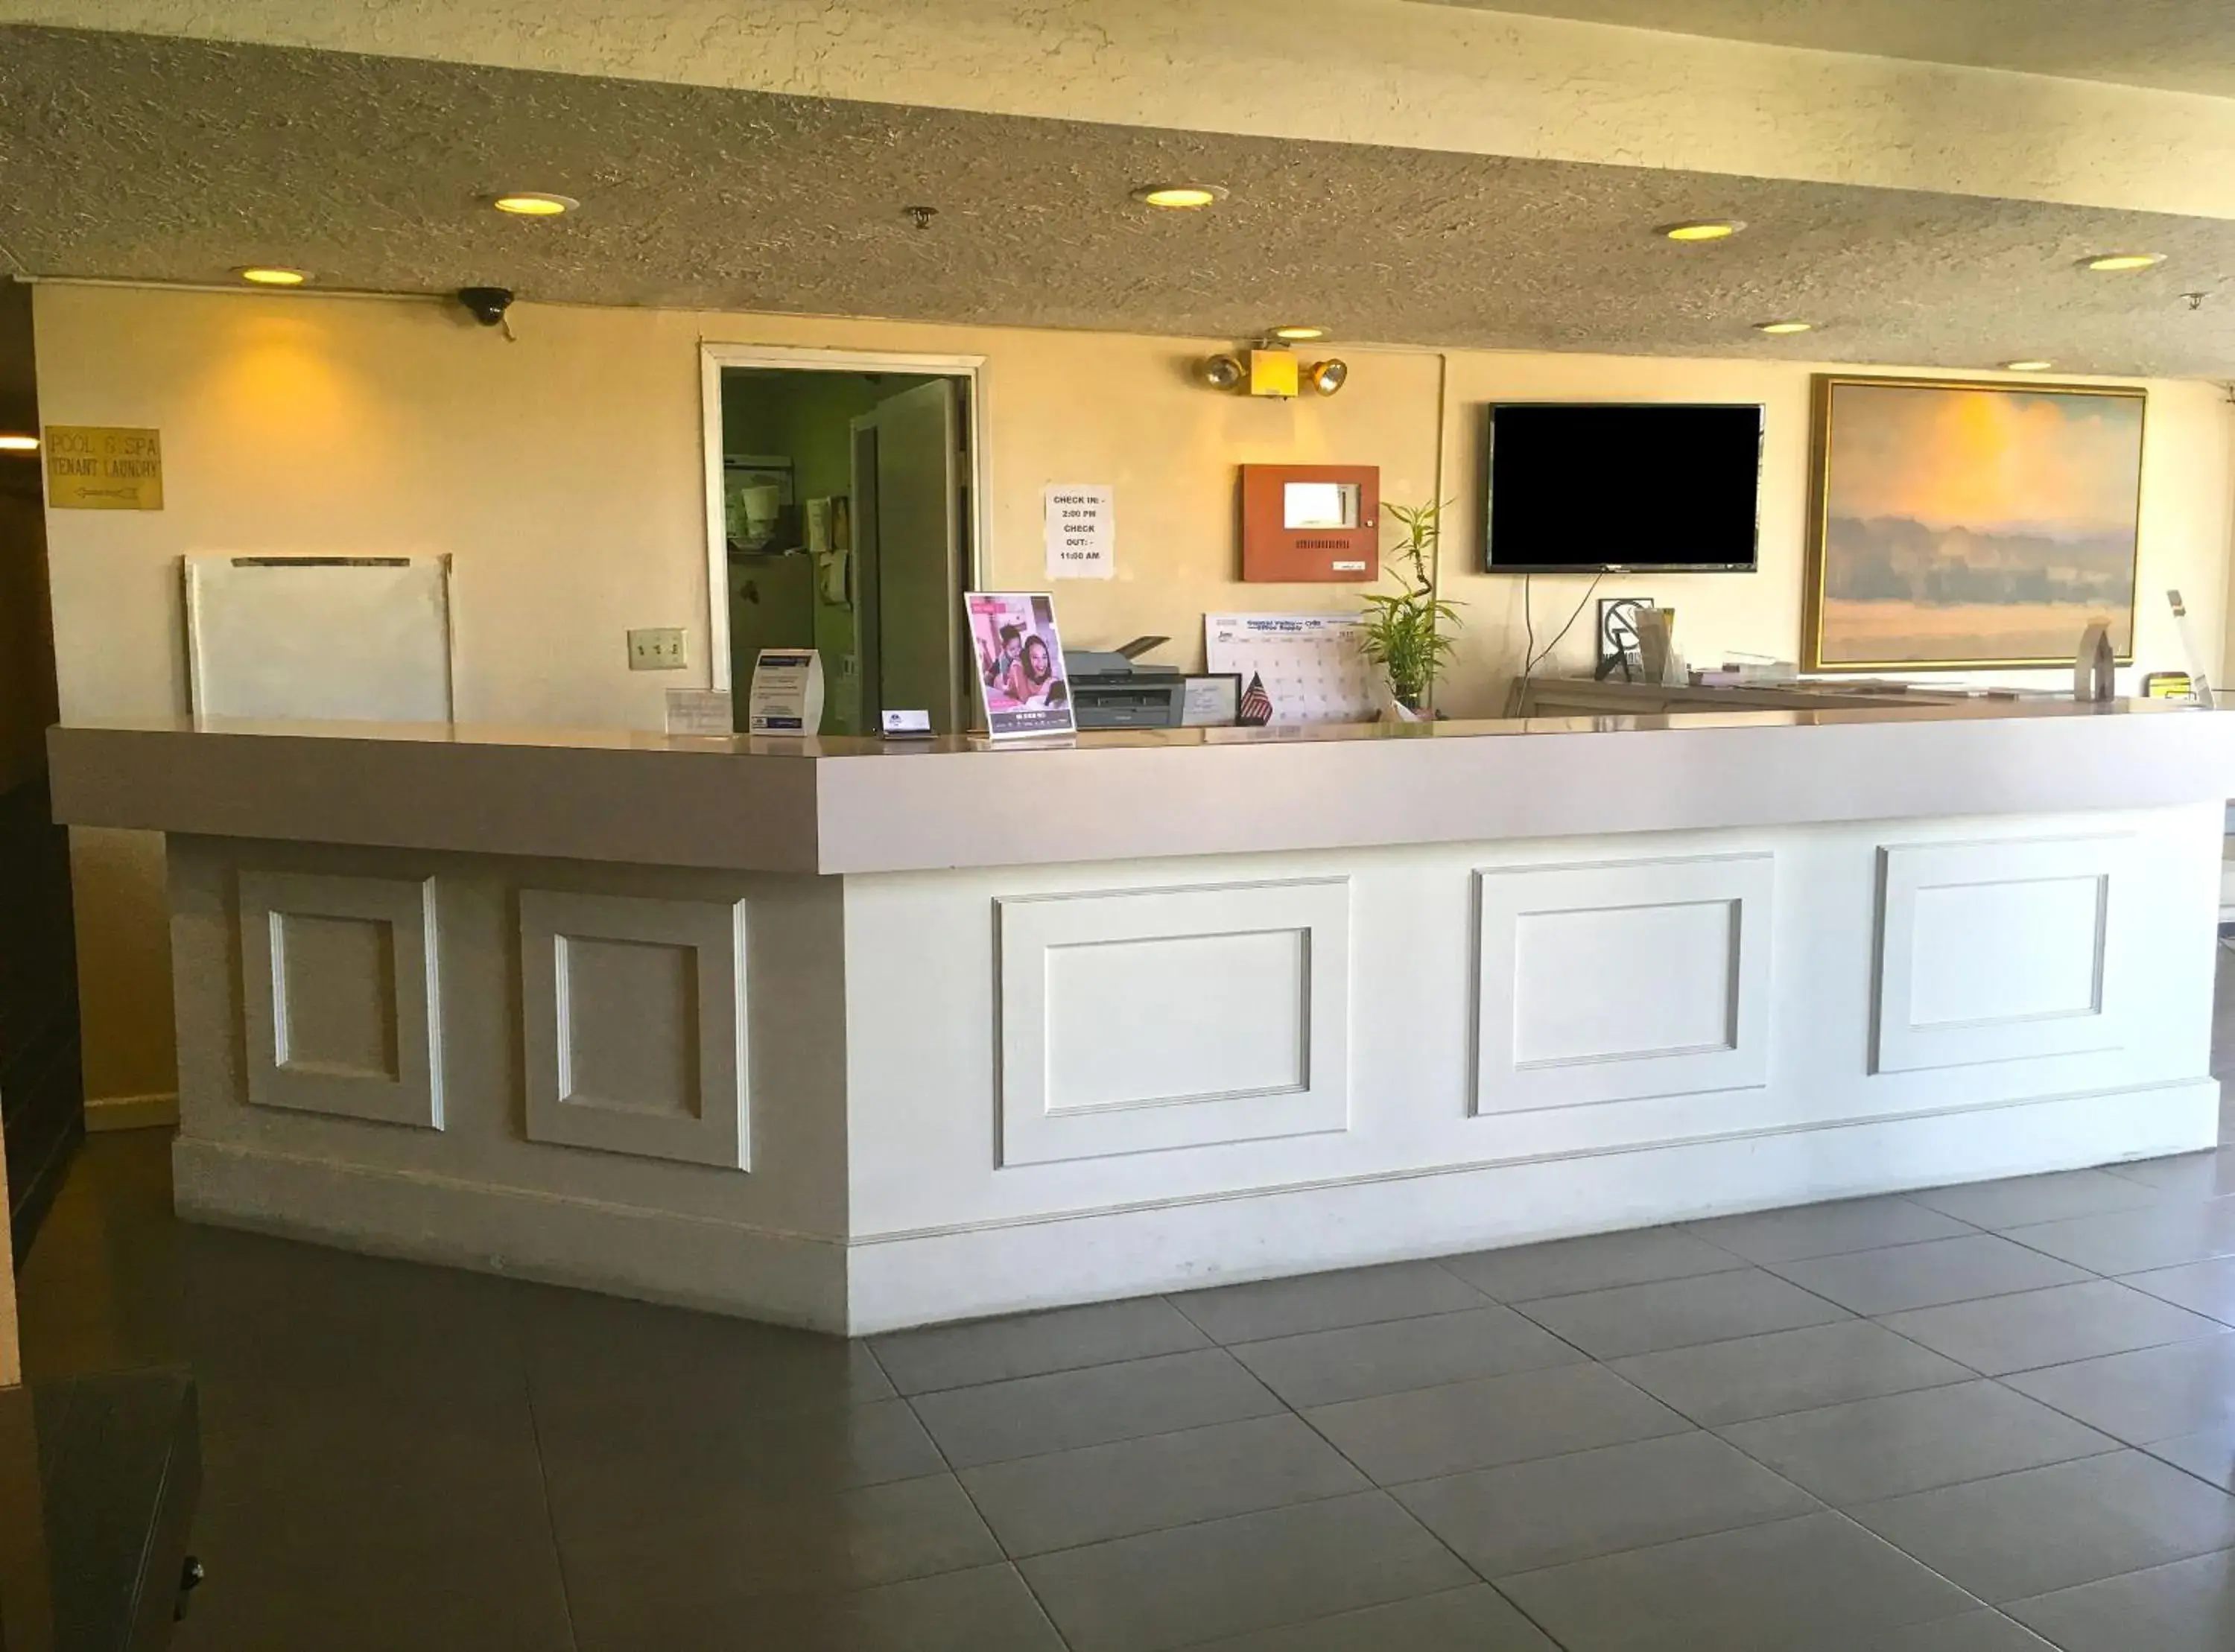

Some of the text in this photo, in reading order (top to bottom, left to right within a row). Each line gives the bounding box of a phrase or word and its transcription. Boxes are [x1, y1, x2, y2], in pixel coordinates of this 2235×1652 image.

[51, 433, 95, 453] POOL
[125, 436, 158, 455] SPA
[52, 457, 161, 477] TENANT LAUNDRY
[1053, 496, 1084, 504] CHECK
[1087, 496, 1099, 504] IN:
[1064, 524, 1094, 533] CHECK
[1061, 552, 1100, 560] 11:00 AM
